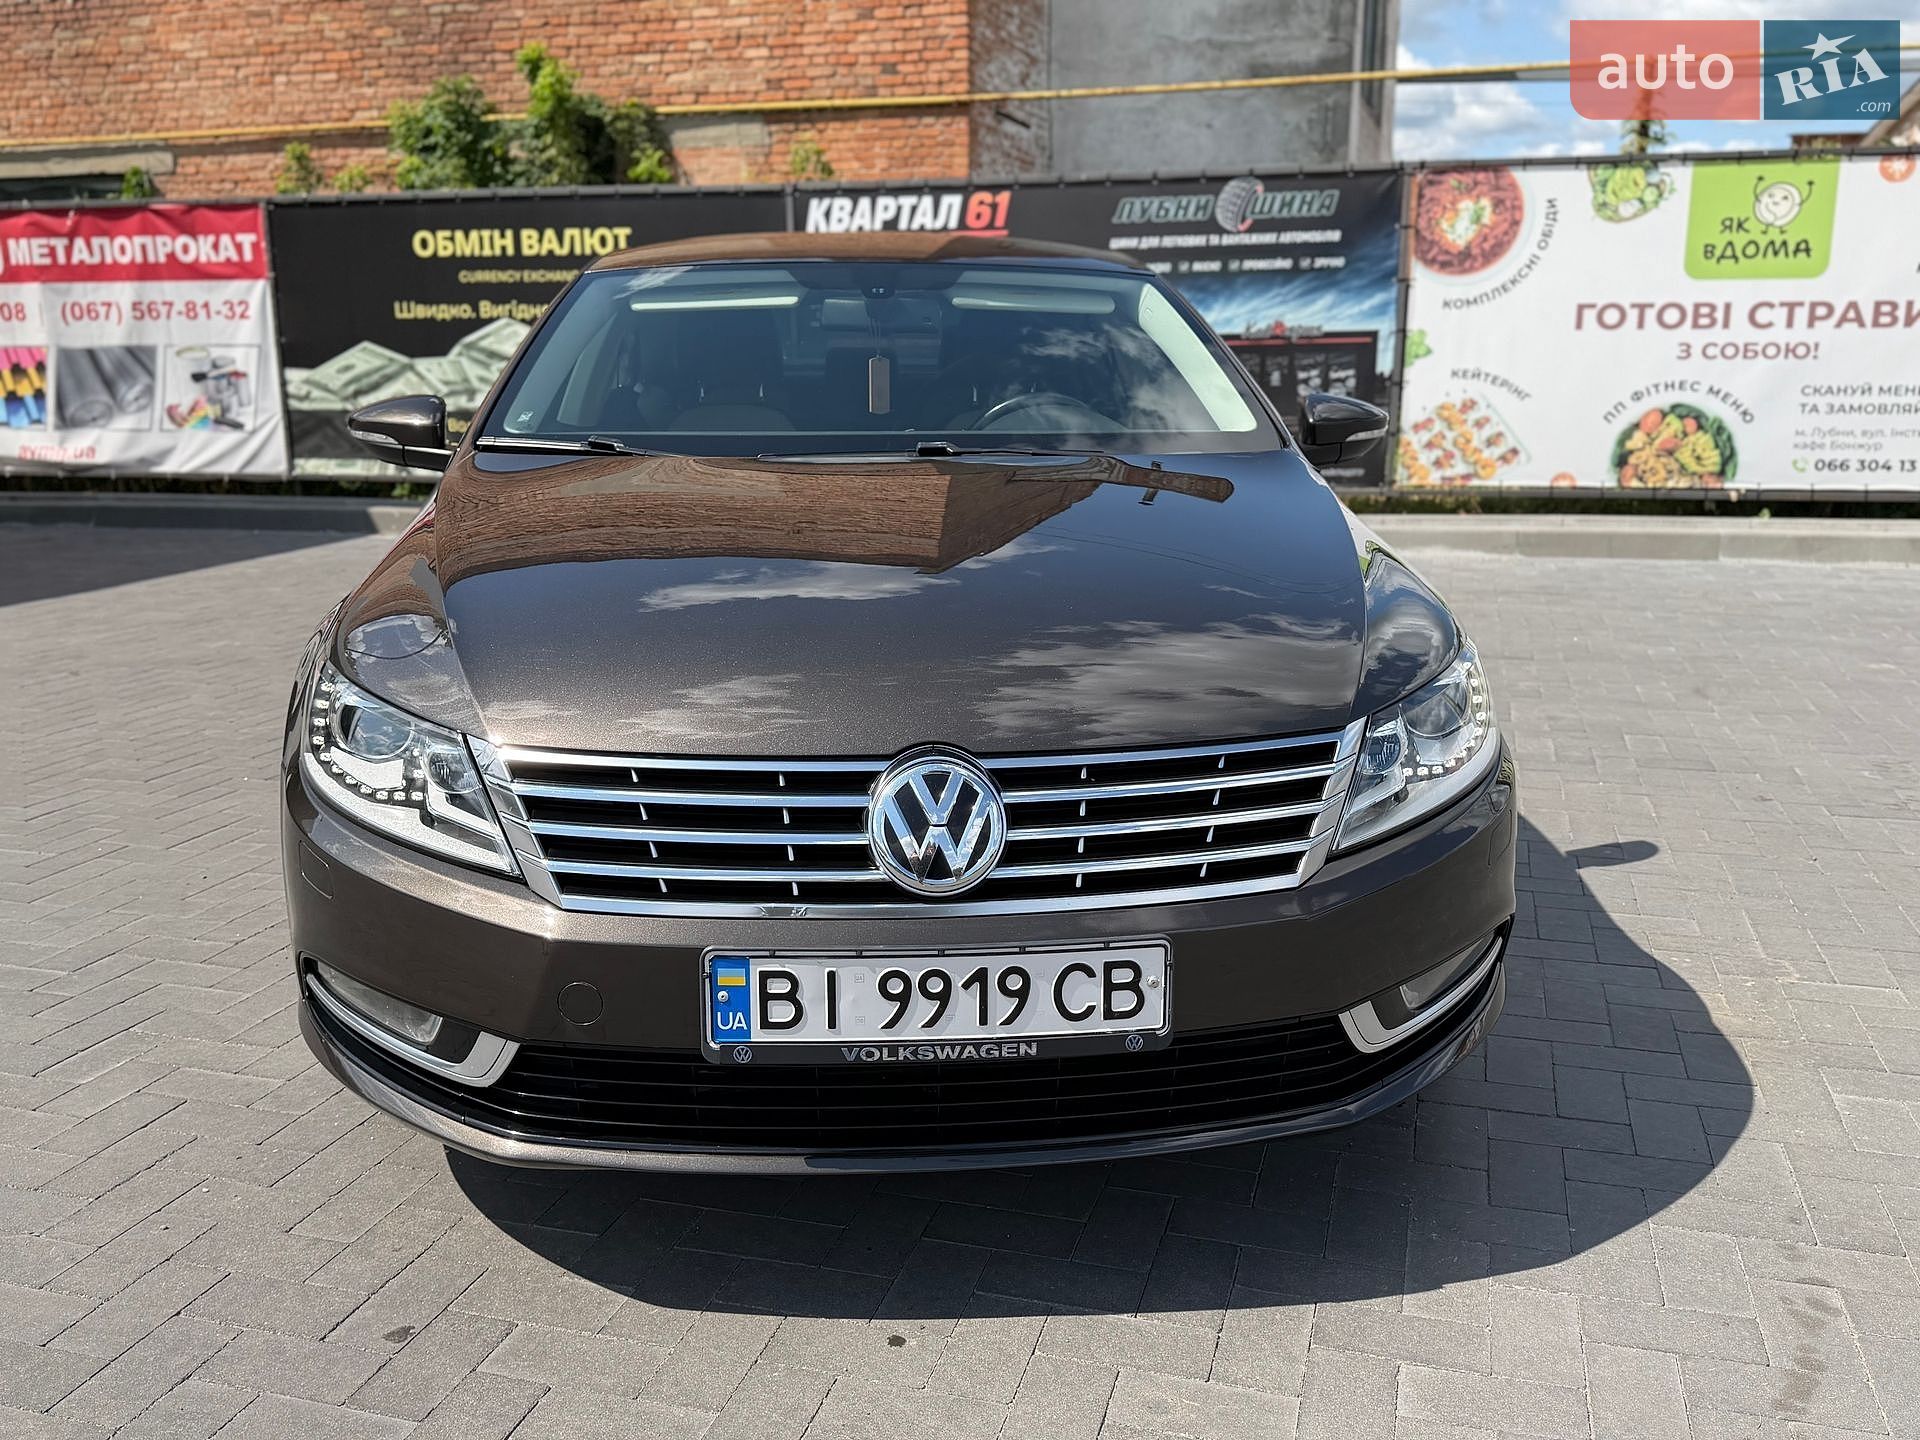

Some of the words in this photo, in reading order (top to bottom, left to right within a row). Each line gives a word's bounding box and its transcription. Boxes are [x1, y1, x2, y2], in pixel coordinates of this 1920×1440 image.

[805, 193, 963, 233] КВАРТАЛ
[964, 190, 1012, 230] 61
[1719, 216, 1751, 234] ЯК
[7, 232, 257, 267] МЕТАЛОПРОКАТ
[411, 229, 516, 259] ОБМІН
[519, 226, 632, 257] ВАЛЮТ
[1442, 253, 1541, 311] КОМПЛЕКСНІ
[1537, 198, 1559, 251] ОБІДИ
[61, 301, 122, 326] (067)
[131, 300, 250, 322] 567-81-32
[1575, 301, 1732, 331] ГОТОВІ
[1701, 341, 1820, 360] СОБОЮ!
[1450, 367, 1532, 401] КЕЙТЕРІНГ
[1800, 382, 1872, 397] СКАНУЙ
[1878, 384, 1920, 397] МЕН
[1630, 380, 1701, 402] ФІТНЕС
[1707, 384, 1755, 424] МЕНЮ
[1799, 402, 1819, 415] ТА
[1814, 458, 1850, 472] 066
[1856, 458, 1892, 472] 304
[1899, 458, 1917, 472] 13
[758, 969, 837, 1031] BI
[877, 965, 1032, 1030] 9919
[1053, 959, 1143, 1022] CB
[716, 1011, 748, 1031] UA
[841, 1042, 1038, 1063] VOLKSWAGEN
